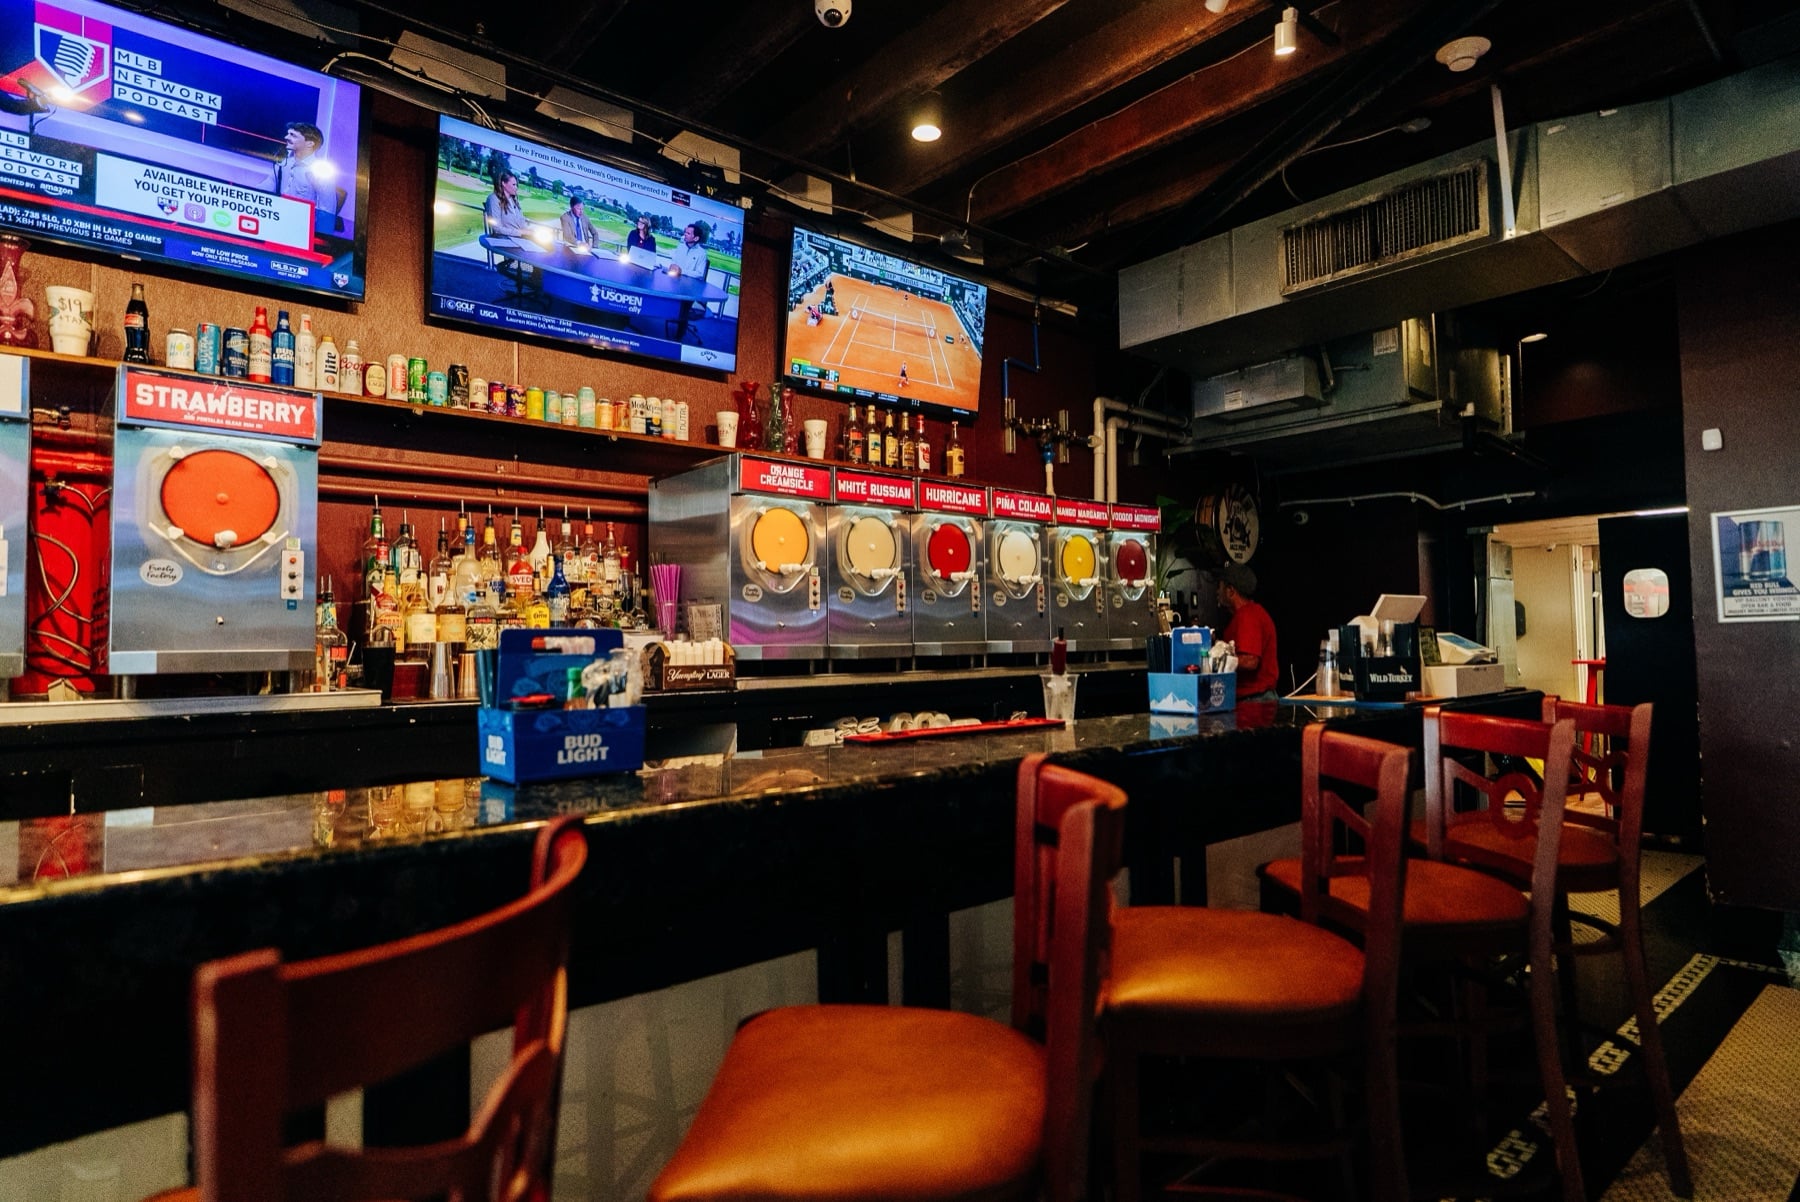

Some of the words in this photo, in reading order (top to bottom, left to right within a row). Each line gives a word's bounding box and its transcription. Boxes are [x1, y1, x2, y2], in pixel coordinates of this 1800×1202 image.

[117, 51, 157, 71] MLB
[118, 69, 217, 106] NETWORK
[118, 87, 213, 121] PODCAST
[0, 132, 25, 145] LB
[5, 148, 79, 173] ETWORK
[3, 162, 76, 185] ODCAST
[514, 144, 530, 155] Live
[531, 149, 550, 161] From
[550, 155, 562, 165] the
[563, 159, 576, 169] U.S.
[577, 164, 606, 179] Women's
[606, 173, 623, 185] Open
[630, 181, 659, 196] presented
[660, 188, 669, 198] by
[40, 182, 73, 195] amazon
[143, 168, 207, 192] AVAILABLE
[209, 183, 273, 207] WHEREVER
[134, 179, 159, 193] YOU
[162, 184, 185, 199] GET
[188, 191, 220, 207] YOUR
[222, 199, 280, 221] PODCASTS
[36, 219, 46, 229] IN
[47, 221, 90, 237] PREVIOUS
[92, 231, 102, 240] 12
[103, 234, 133, 245] GAMES
[92, 223, 101, 232] IN
[102, 226, 122, 236] LAST
[124, 230, 134, 239] 10
[135, 232, 162, 245] GAMES
[216, 249, 231, 257] LOW
[456, 301, 475, 310] GOLF
[480, 309, 499, 320] USGA
[628, 306, 642, 315] ally
[324, 351, 338, 375] Lite
[135, 383, 307, 425] STRAWBERRY
[770, 464, 805, 479] ORANGE
[760, 474, 814, 491] CREAMSICLE
[869, 483, 911, 500] RUSSIAN
[925, 487, 981, 507] HURRICANE
[1018, 499, 1051, 514] COLADA
[512, 575, 532, 584] SVED
[706, 671, 730, 680] LAGER
[564, 733, 602, 750] BUD
[557, 746, 610, 765] LIGHT
